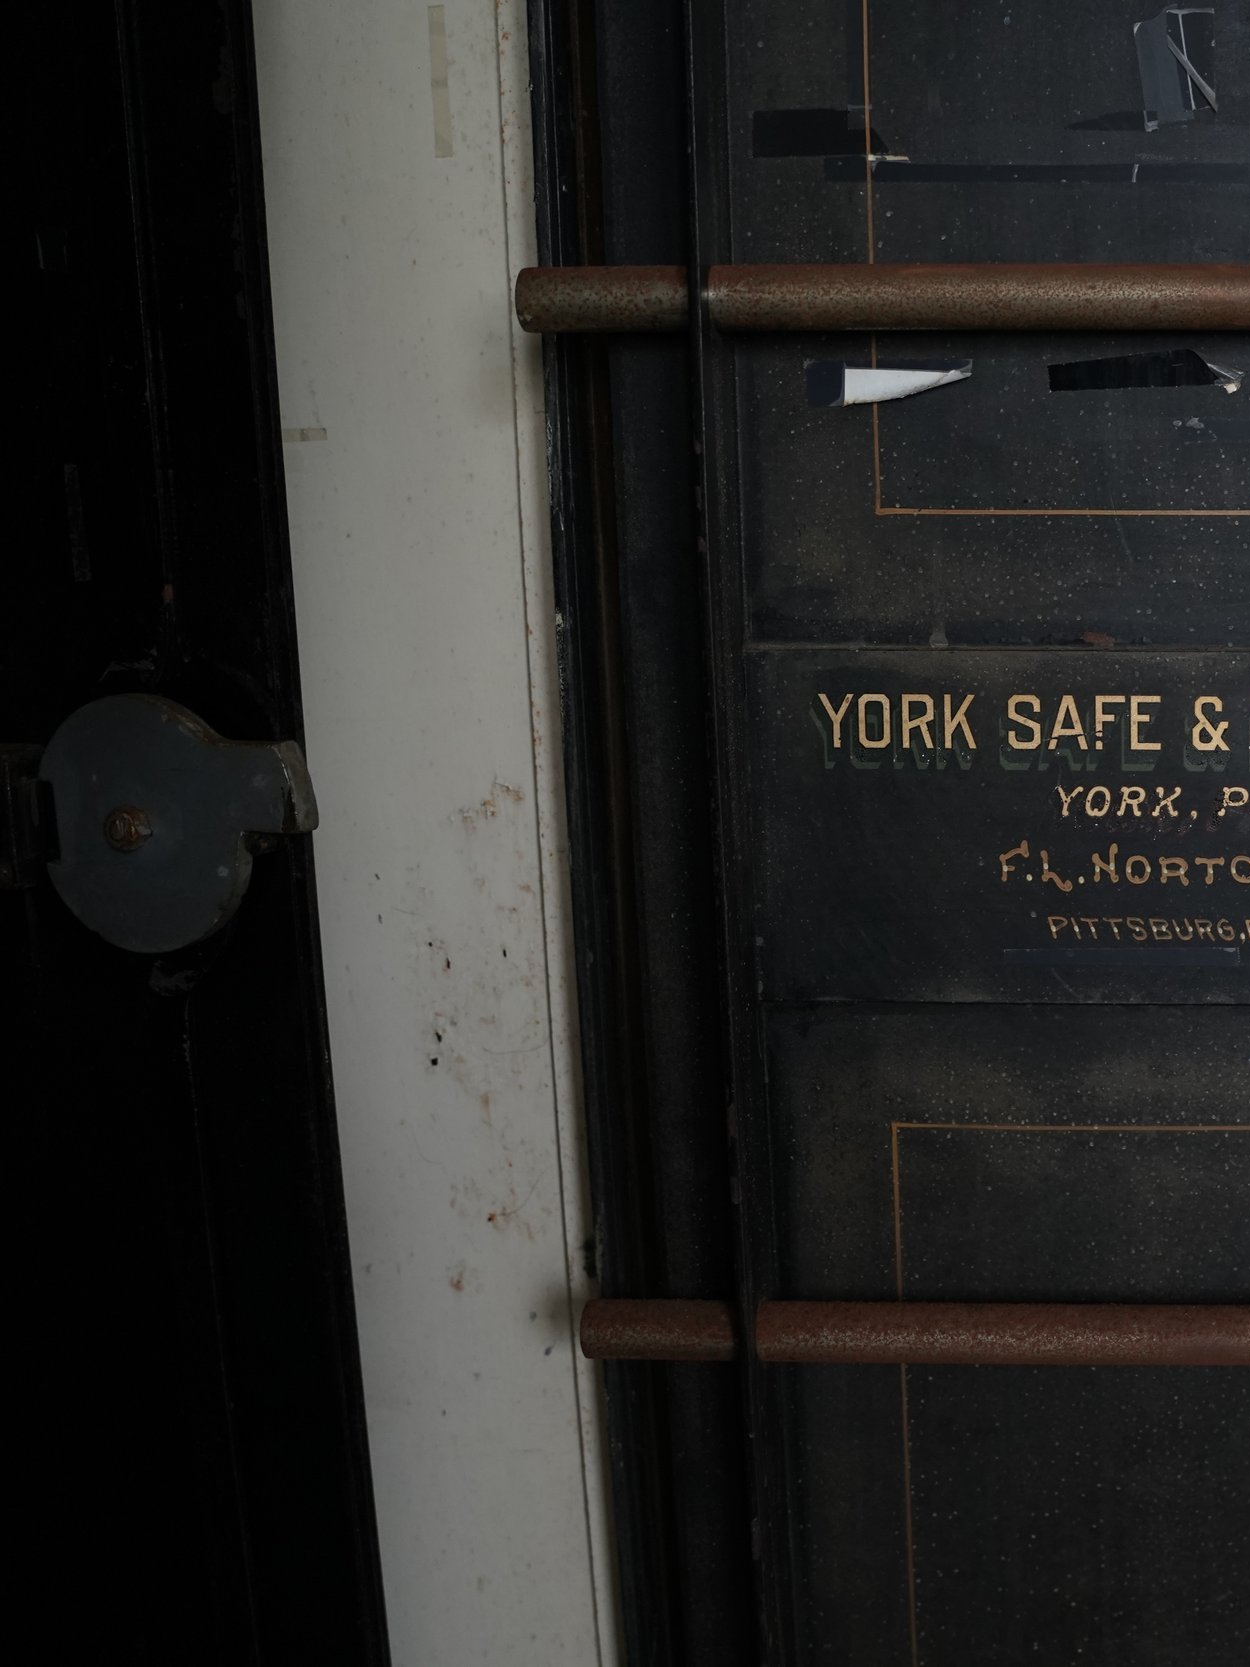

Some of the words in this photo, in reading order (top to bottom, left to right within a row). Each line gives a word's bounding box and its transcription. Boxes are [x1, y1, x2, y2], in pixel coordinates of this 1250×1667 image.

[817, 693, 978, 750] YORK
[1006, 694, 1162, 752] SAFE
[1191, 695, 1231, 752] &
[1056, 785, 1198, 820] YORK,
